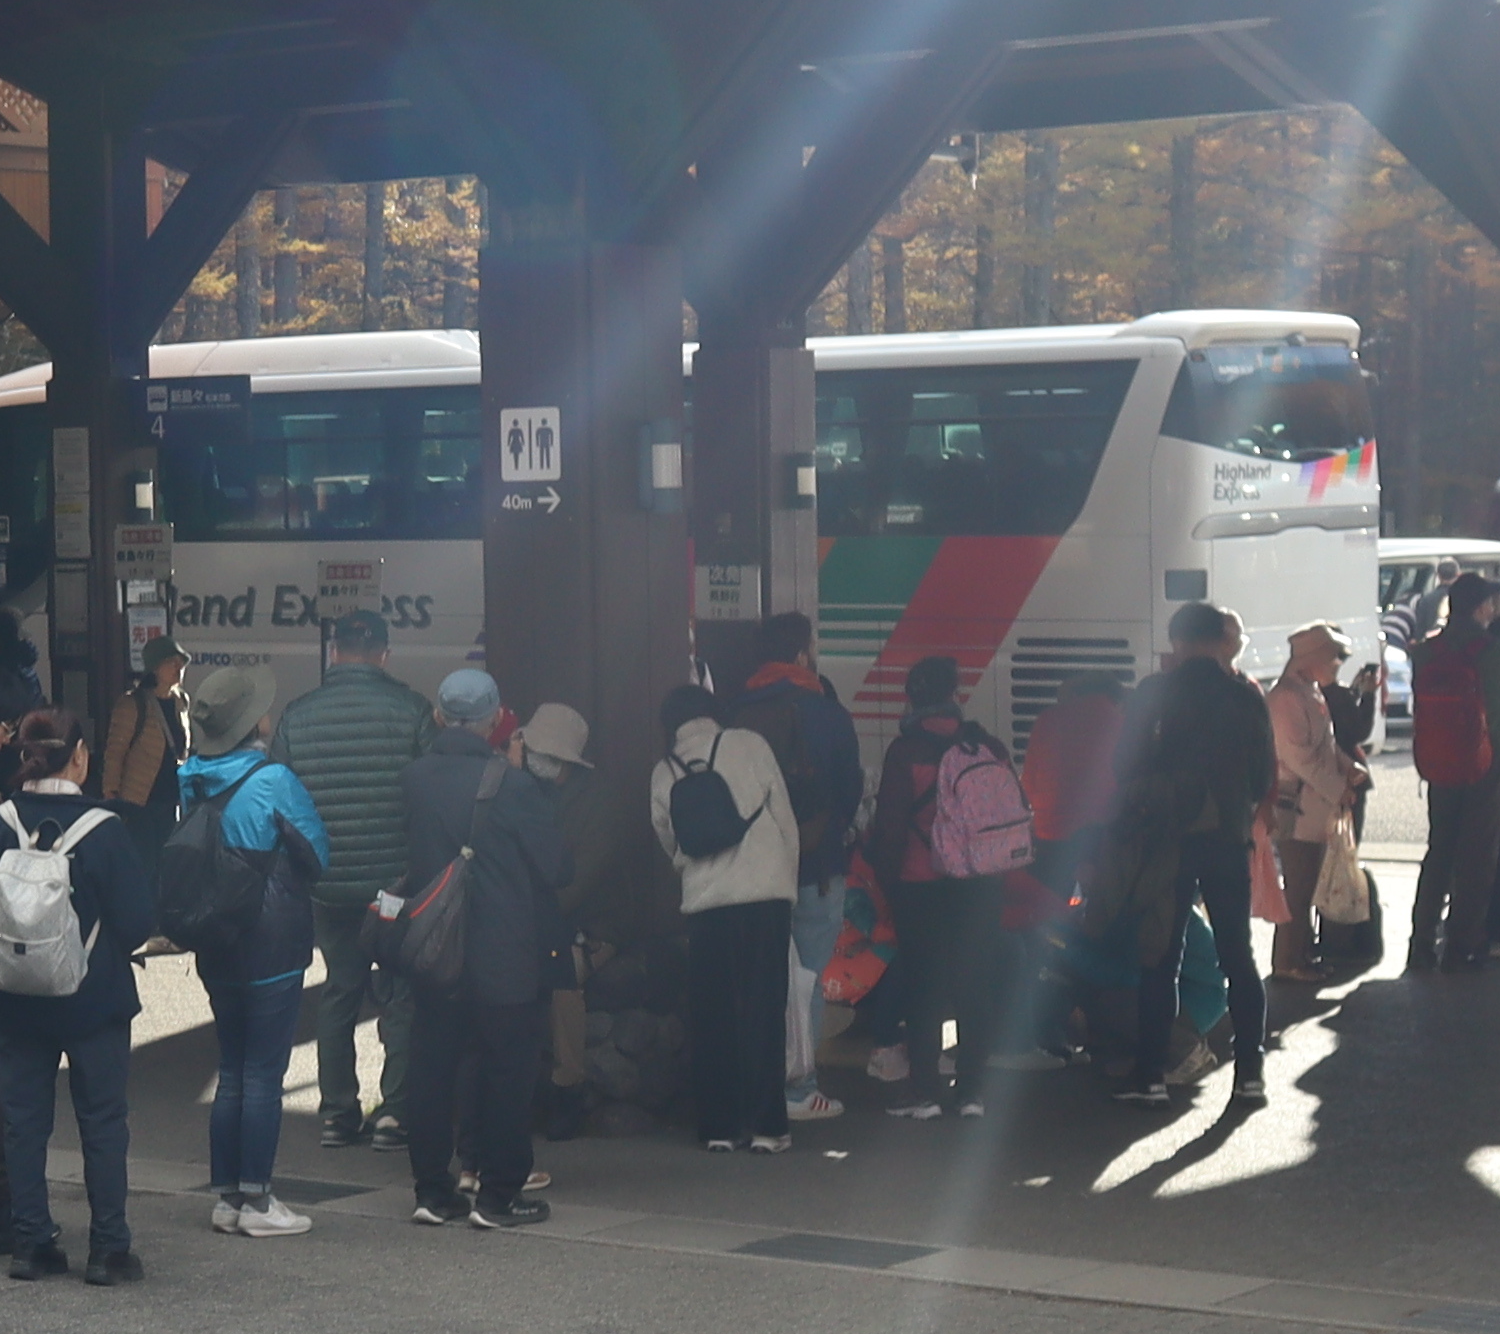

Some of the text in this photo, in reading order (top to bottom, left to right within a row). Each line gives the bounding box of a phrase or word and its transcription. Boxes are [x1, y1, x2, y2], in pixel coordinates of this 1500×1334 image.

[151, 414, 166, 439] 4
[1214, 462, 1272, 483] Highland
[501, 492, 533, 512] 40m
